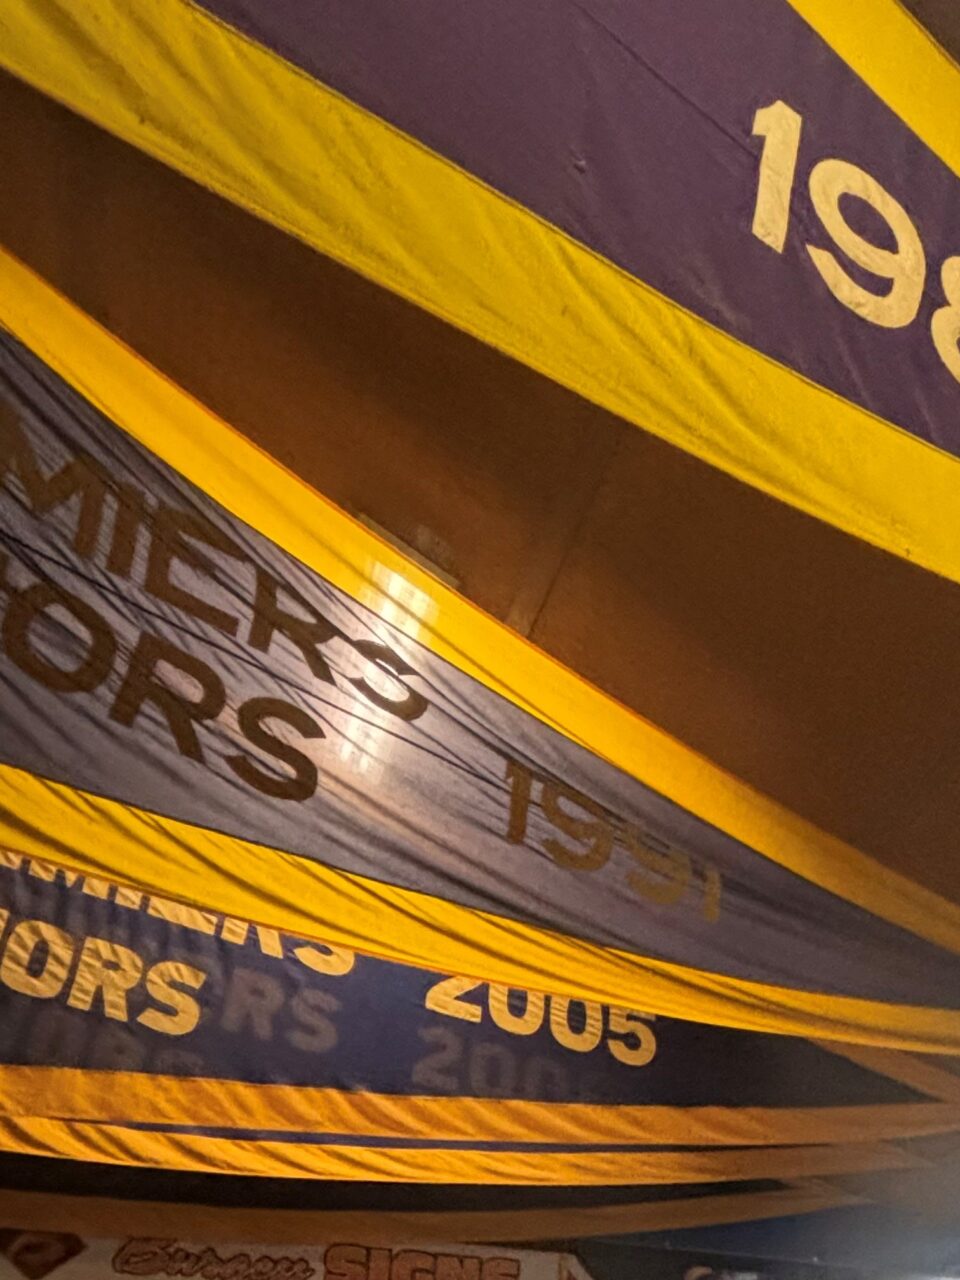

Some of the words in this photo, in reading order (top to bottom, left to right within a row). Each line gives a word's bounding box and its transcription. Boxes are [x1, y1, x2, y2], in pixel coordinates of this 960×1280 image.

[0, 552, 327, 801] ORS
[0, 906, 206, 1036] ORS
[425, 975, 656, 1067] 2005
